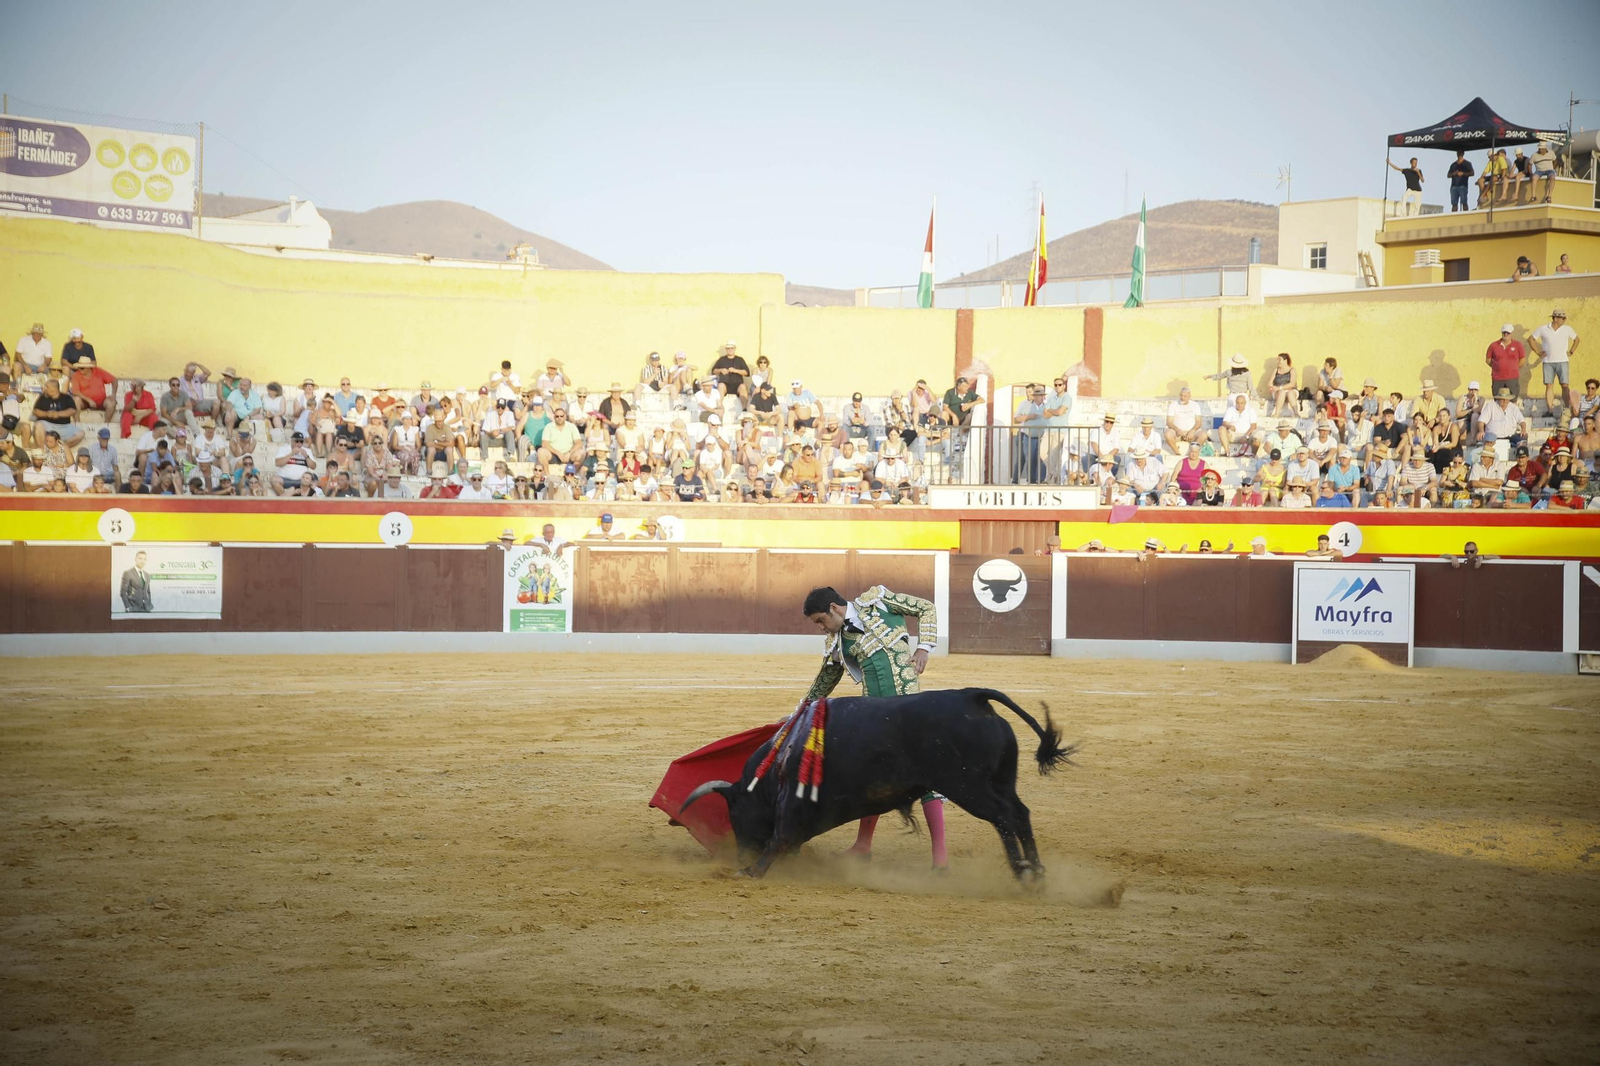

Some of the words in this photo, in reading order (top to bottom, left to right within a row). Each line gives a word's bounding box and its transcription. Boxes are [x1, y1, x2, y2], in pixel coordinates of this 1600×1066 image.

[18, 127, 55, 147] IBAÑEZ
[1405, 134, 1435, 144] 24MX
[1454, 130, 1486, 139] 24MX
[1505, 130, 1528, 138] 24MX
[18, 146, 77, 167] FERNÁNDEZ
[111, 207, 133, 220] 633
[136, 209, 158, 222] 527
[162, 212, 184, 225] 596
[963, 491, 1063, 506] TORILES
[110, 519, 122, 534] 5
[390, 522, 401, 536] 5
[1338, 533, 1350, 547] 4
[508, 549, 539, 578] CASTALA
[1314, 605, 1393, 627] Mayfra
[1322, 628, 1344, 636] OBRAS
[1351, 629, 1385, 637] SERVICIOS
